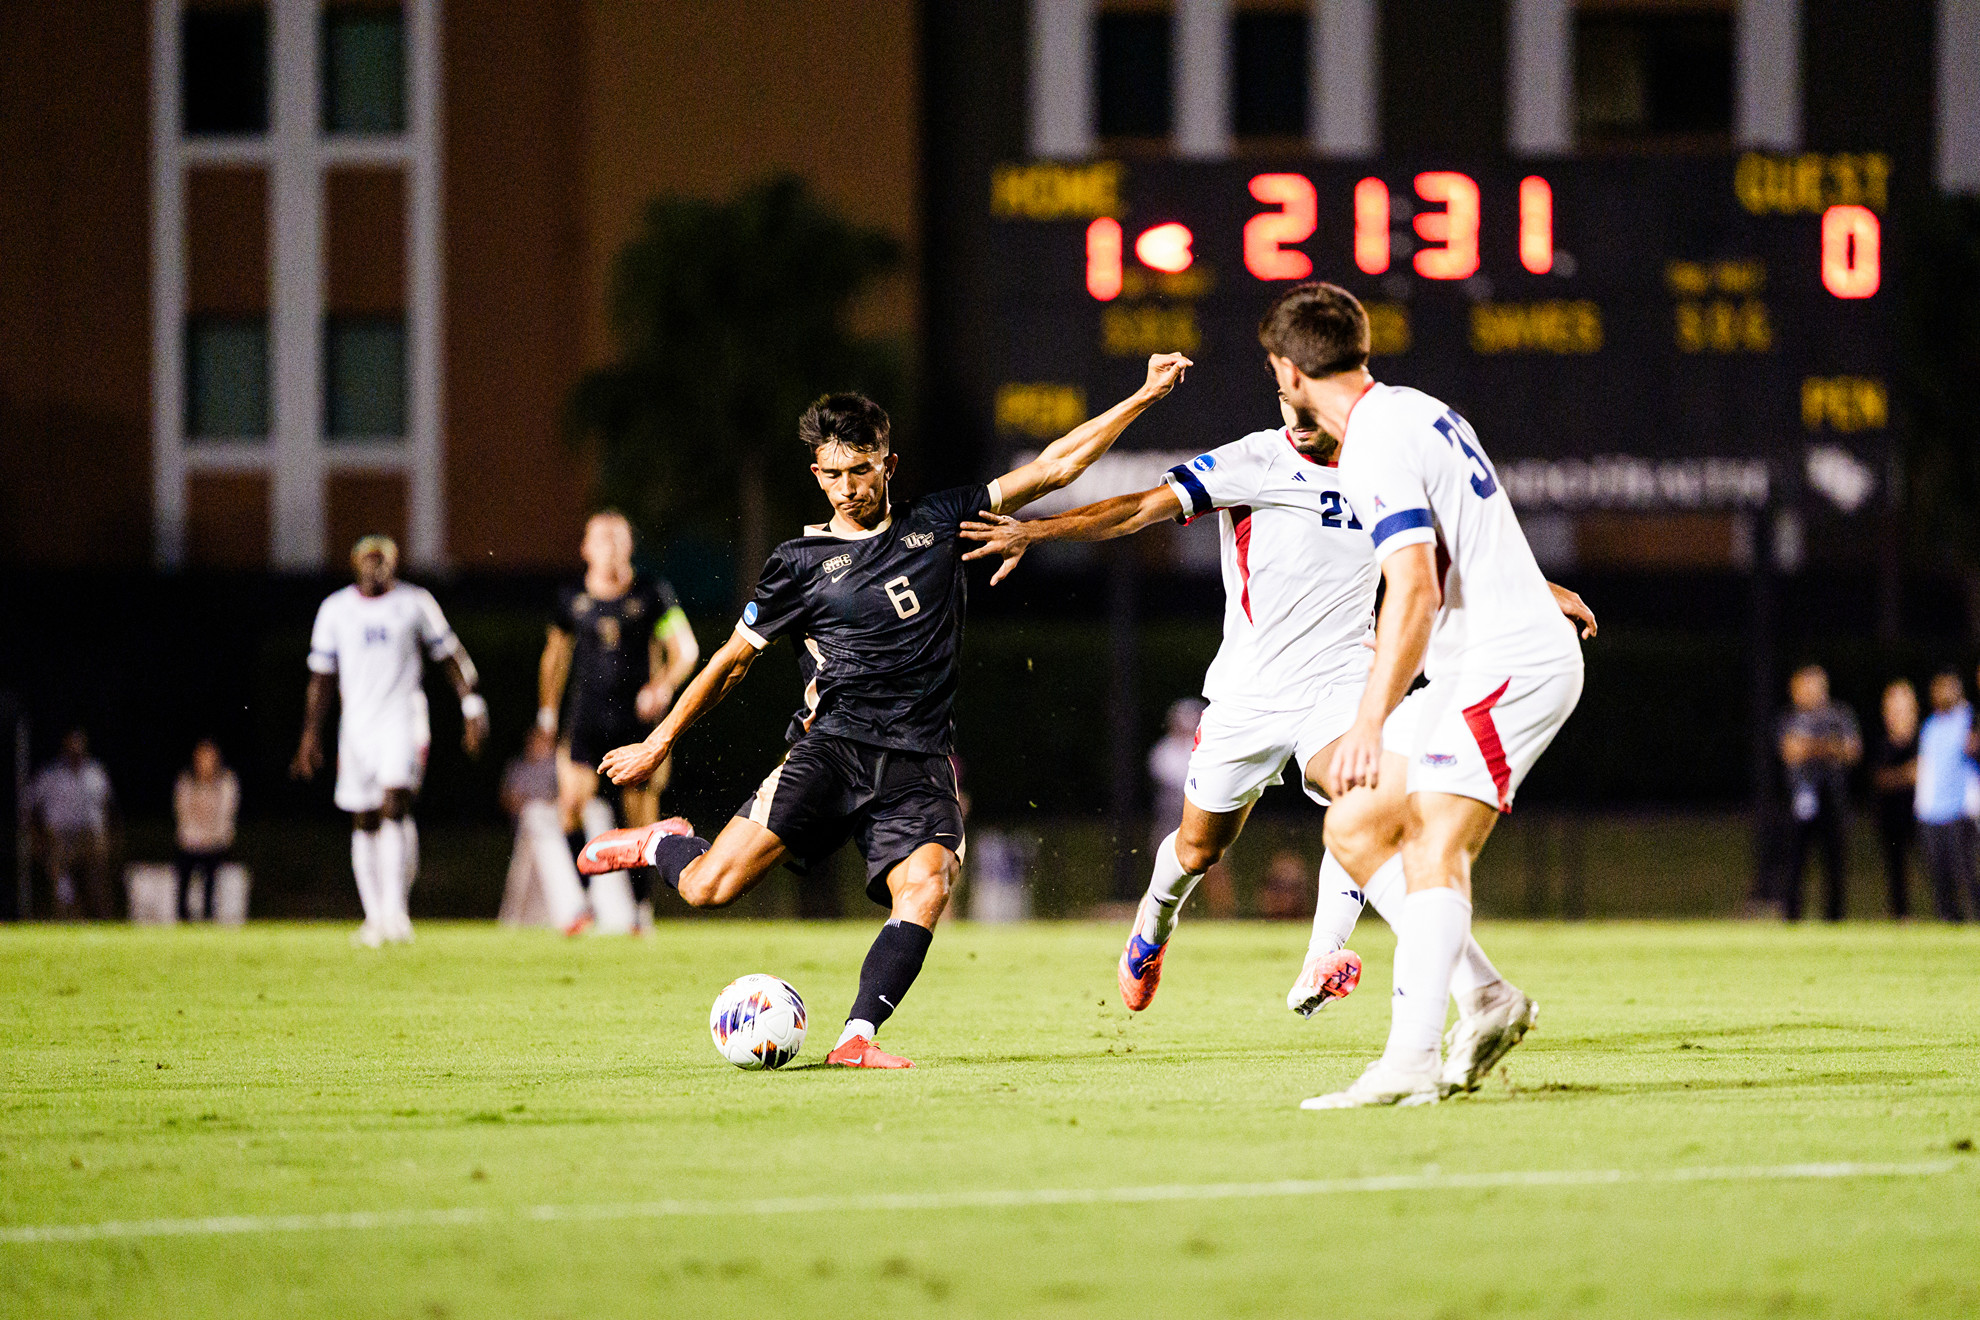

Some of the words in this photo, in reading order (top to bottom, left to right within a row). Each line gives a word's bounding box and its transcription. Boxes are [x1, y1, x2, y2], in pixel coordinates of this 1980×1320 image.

[1821, 204, 1881, 300] 0
[1432, 408, 1500, 500] 3
[901, 532, 935, 549] UCF
[884, 575, 921, 620] 6
